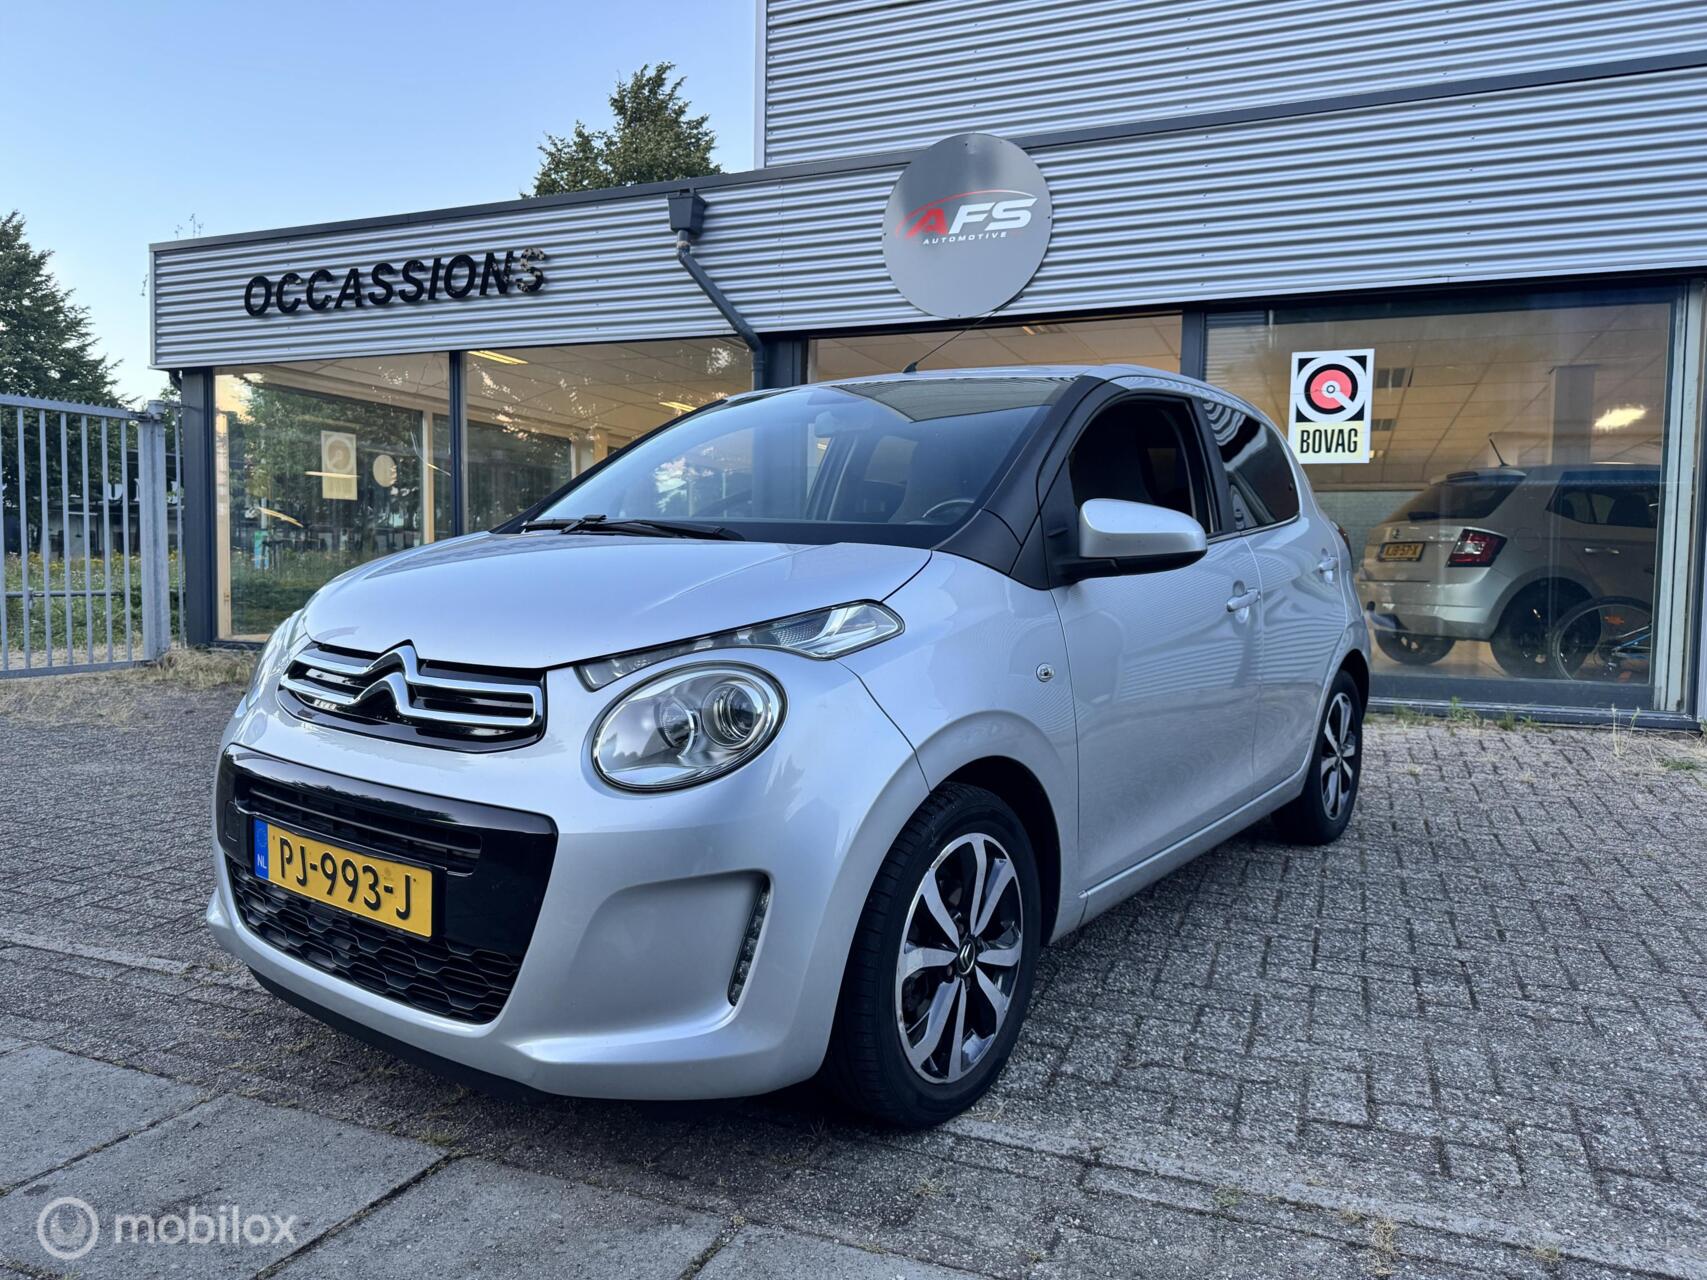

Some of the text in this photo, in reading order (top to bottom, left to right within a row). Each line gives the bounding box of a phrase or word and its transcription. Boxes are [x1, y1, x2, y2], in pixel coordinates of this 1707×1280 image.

[904, 198, 1038, 239] AFS
[922, 231, 1008, 245] AUTOMOTIVE
[244, 248, 546, 317] OCCASSIONS
[1300, 428, 1358, 454] BOVAG
[257, 854, 267, 869] NL
[279, 835, 411, 920] PJ-993-J
